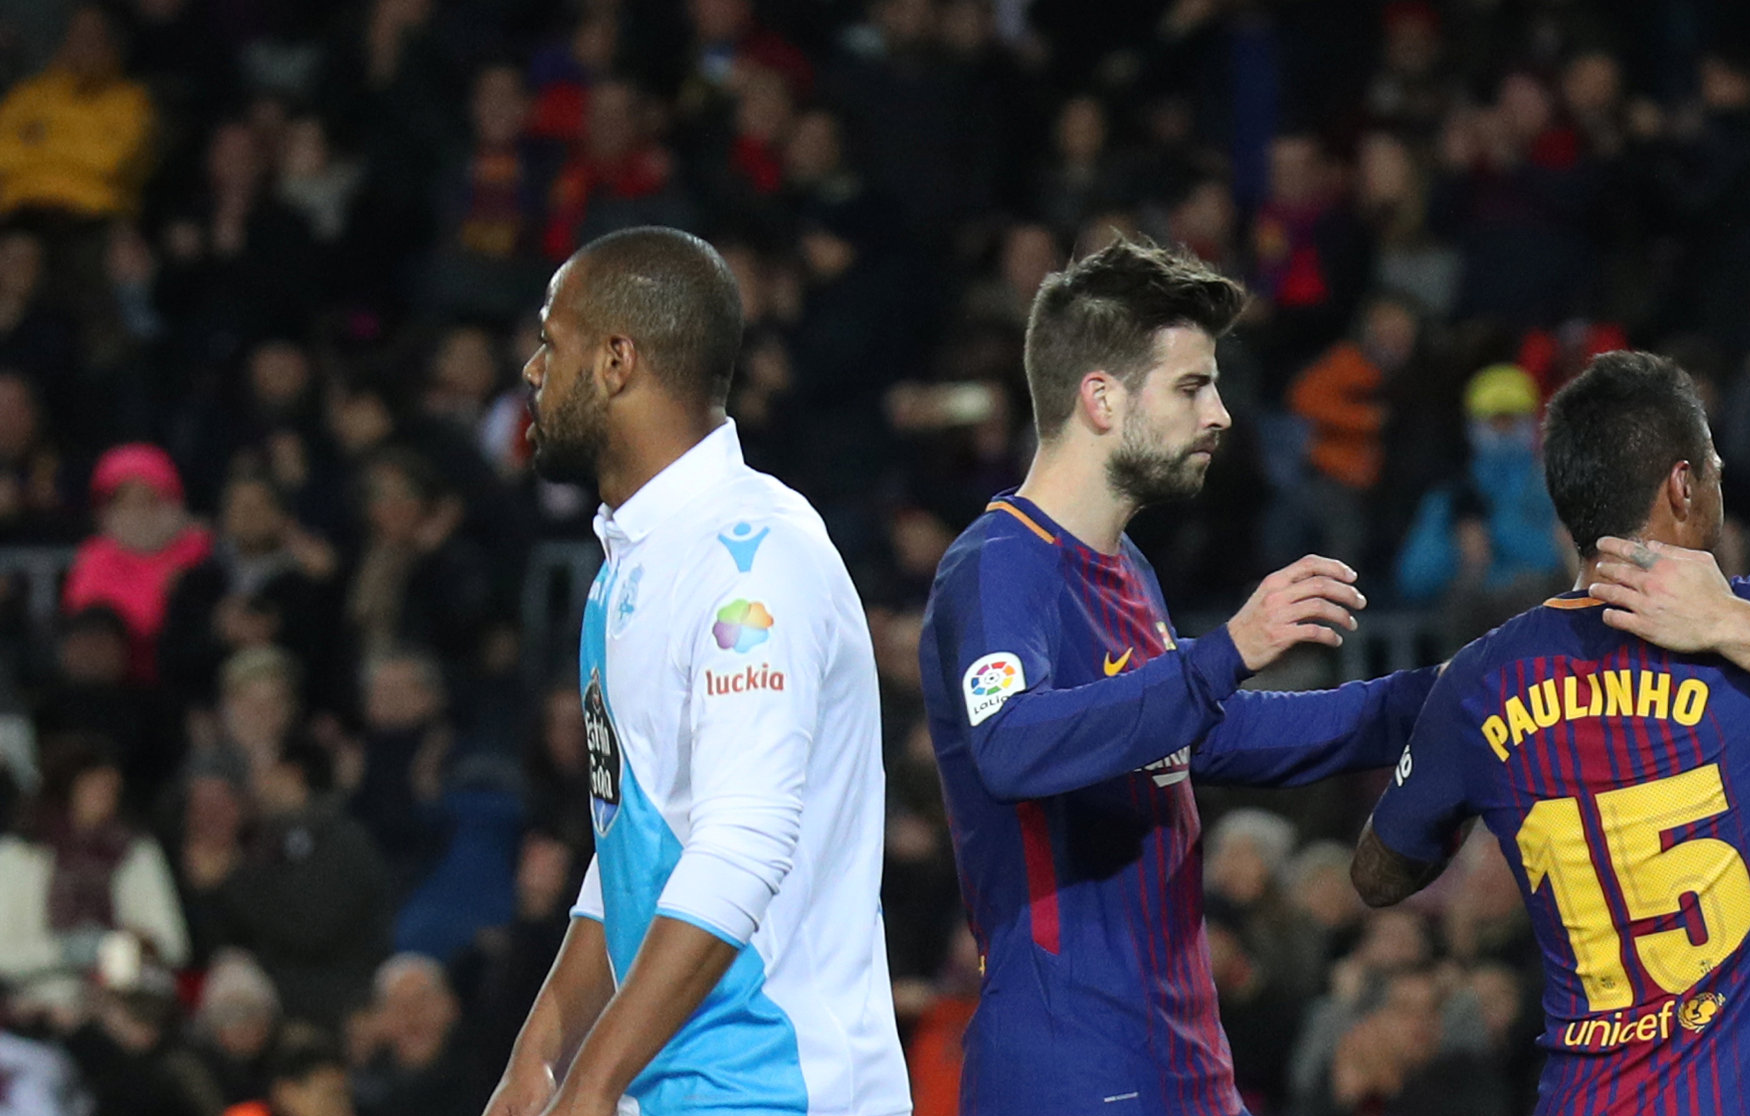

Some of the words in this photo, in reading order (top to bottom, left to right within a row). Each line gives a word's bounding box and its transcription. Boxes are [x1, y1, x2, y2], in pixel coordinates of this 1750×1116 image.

[705, 663, 785, 696] luckia
[1481, 669, 1709, 762] PAULINHO
[1564, 1000, 1676, 1048] unicef
